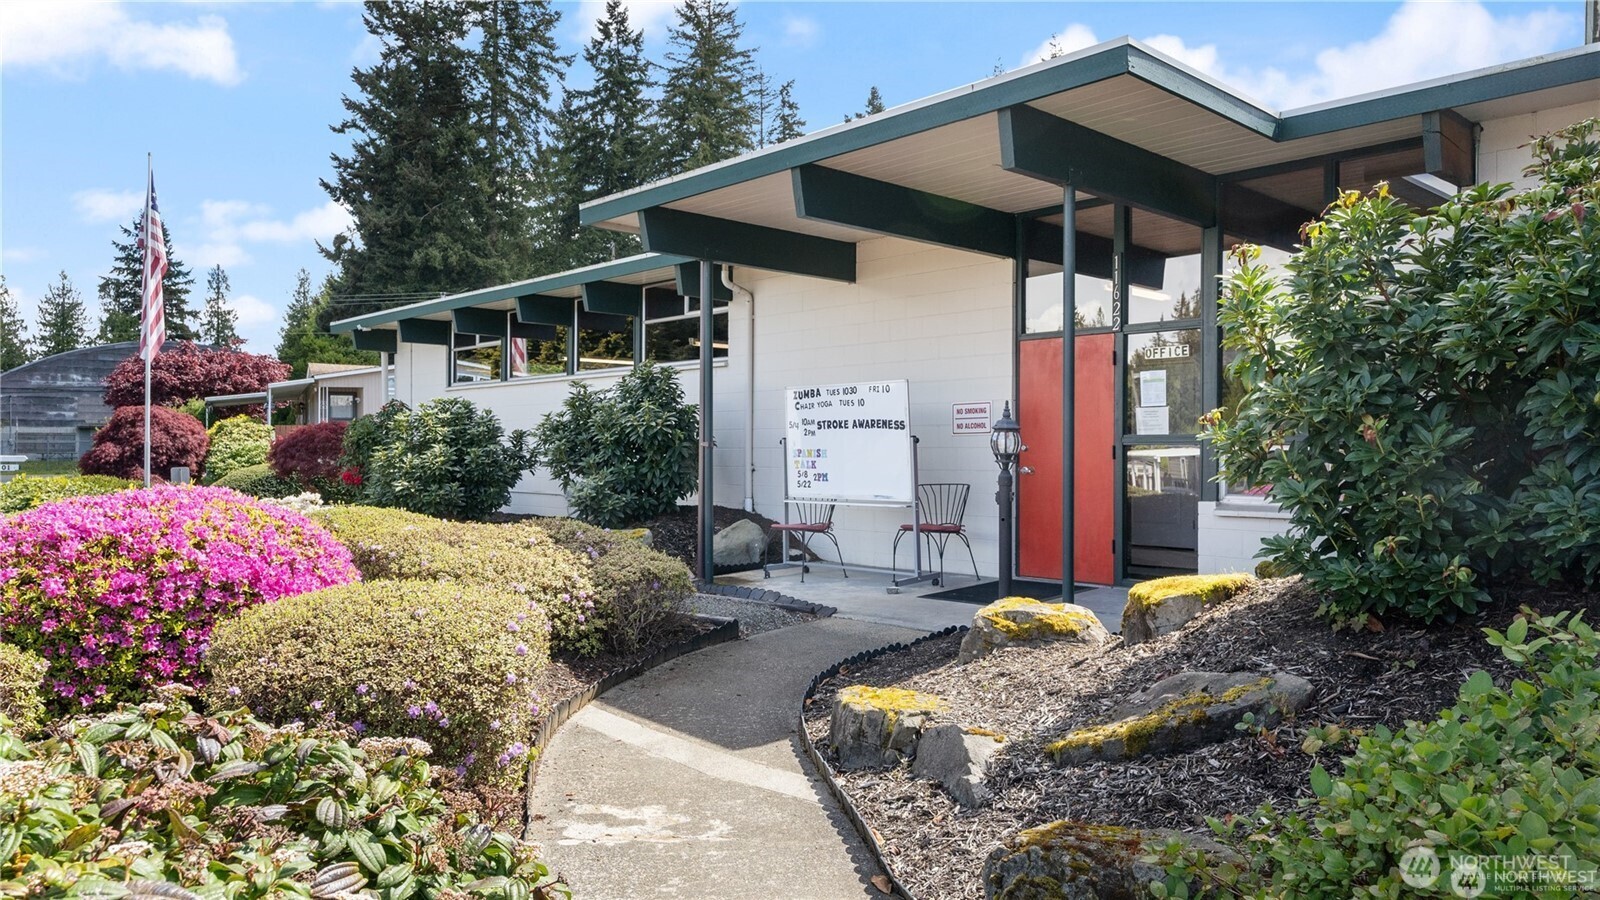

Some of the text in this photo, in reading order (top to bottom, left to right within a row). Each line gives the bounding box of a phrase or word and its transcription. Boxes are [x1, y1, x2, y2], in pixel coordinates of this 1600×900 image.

[1112, 255, 1121, 331] 11622
[1145, 346, 1189, 358] OFFICE
[793, 384, 891, 400] ZUMBA TUES 1030 FRI 10
[794, 398, 865, 411] CHAIR YOGA TUES 10
[816, 418, 906, 431] STROKE AWARENESS
[792, 448, 828, 459] SPANISH
[793, 460, 817, 470] TALK
[797, 469, 809, 479] 5/8
[812, 472, 829, 483] 2PM
[797, 479, 812, 489] 5/22
